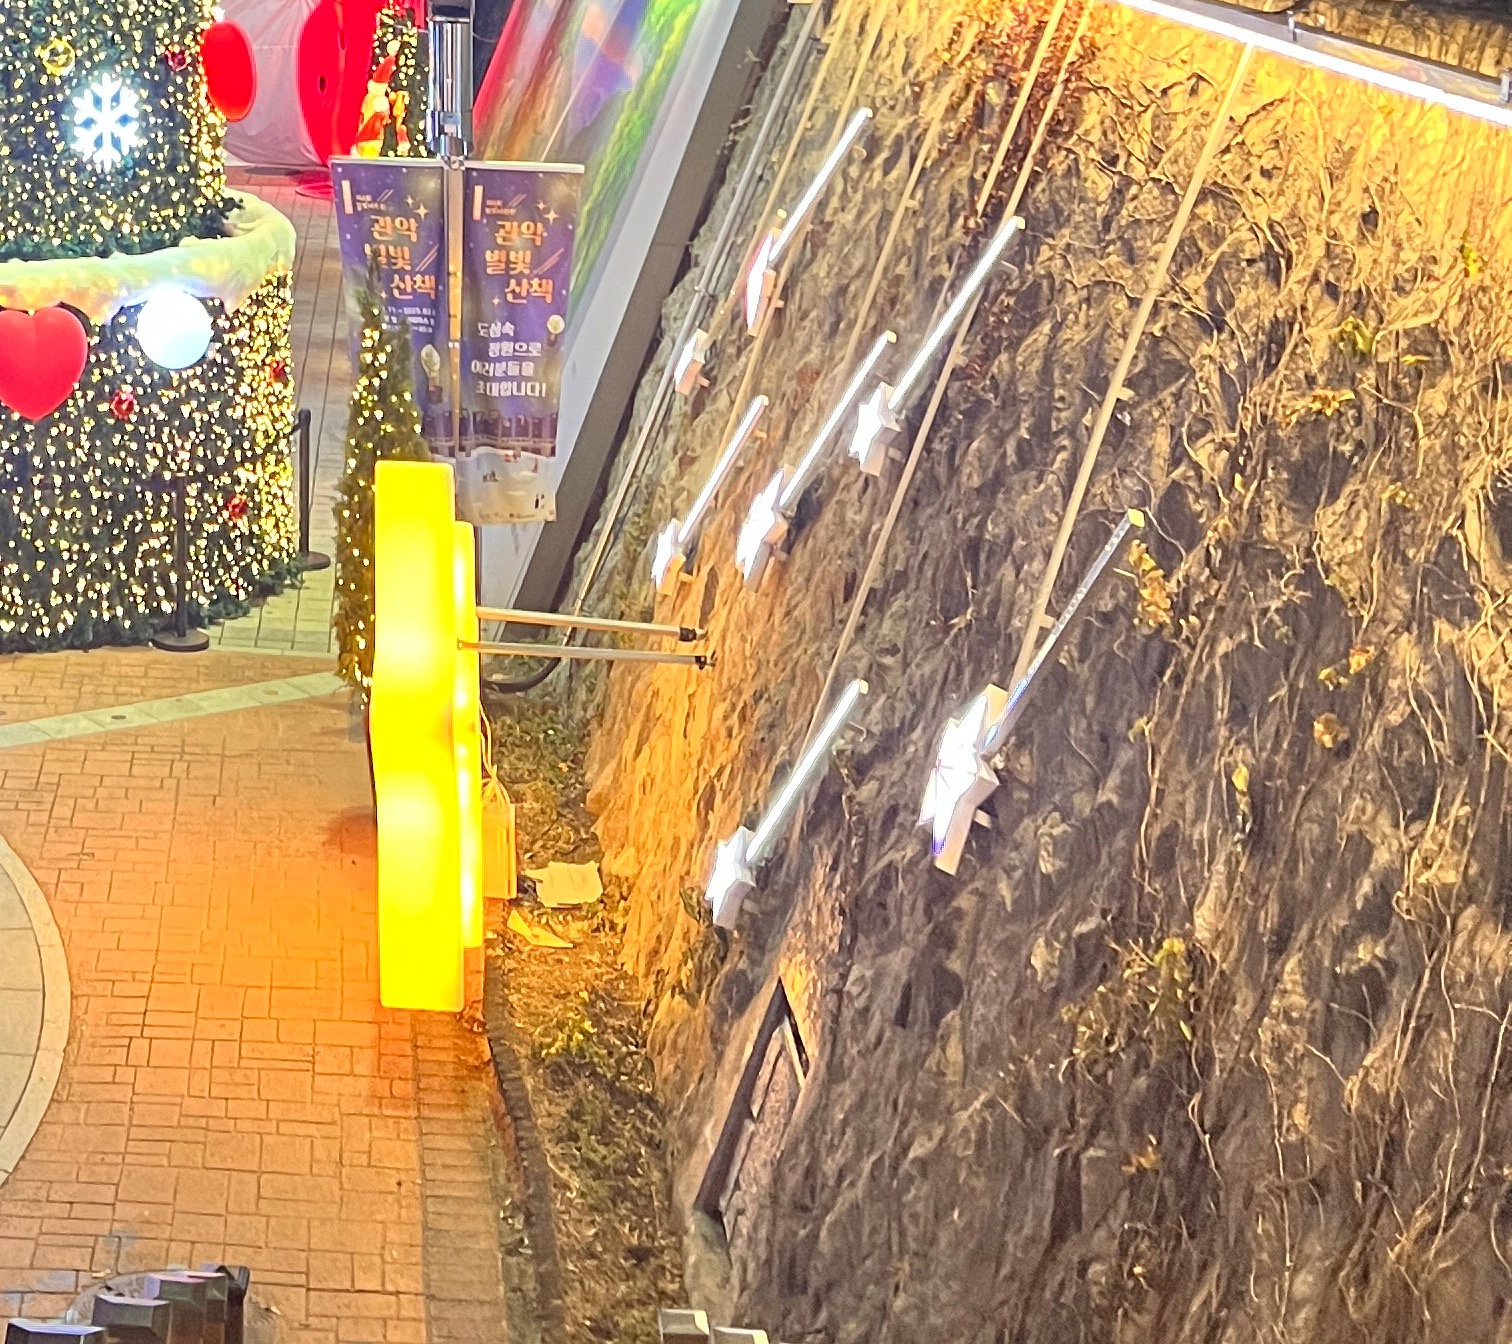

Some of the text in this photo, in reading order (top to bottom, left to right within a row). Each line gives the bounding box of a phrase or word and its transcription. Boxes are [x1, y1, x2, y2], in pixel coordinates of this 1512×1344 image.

[370, 215, 418, 242] 관악
[495, 221, 544, 246] 관악
[485, 249, 531, 275] 별빛
[390, 274, 436, 300] 산책
[505, 277, 553, 304] 산책
